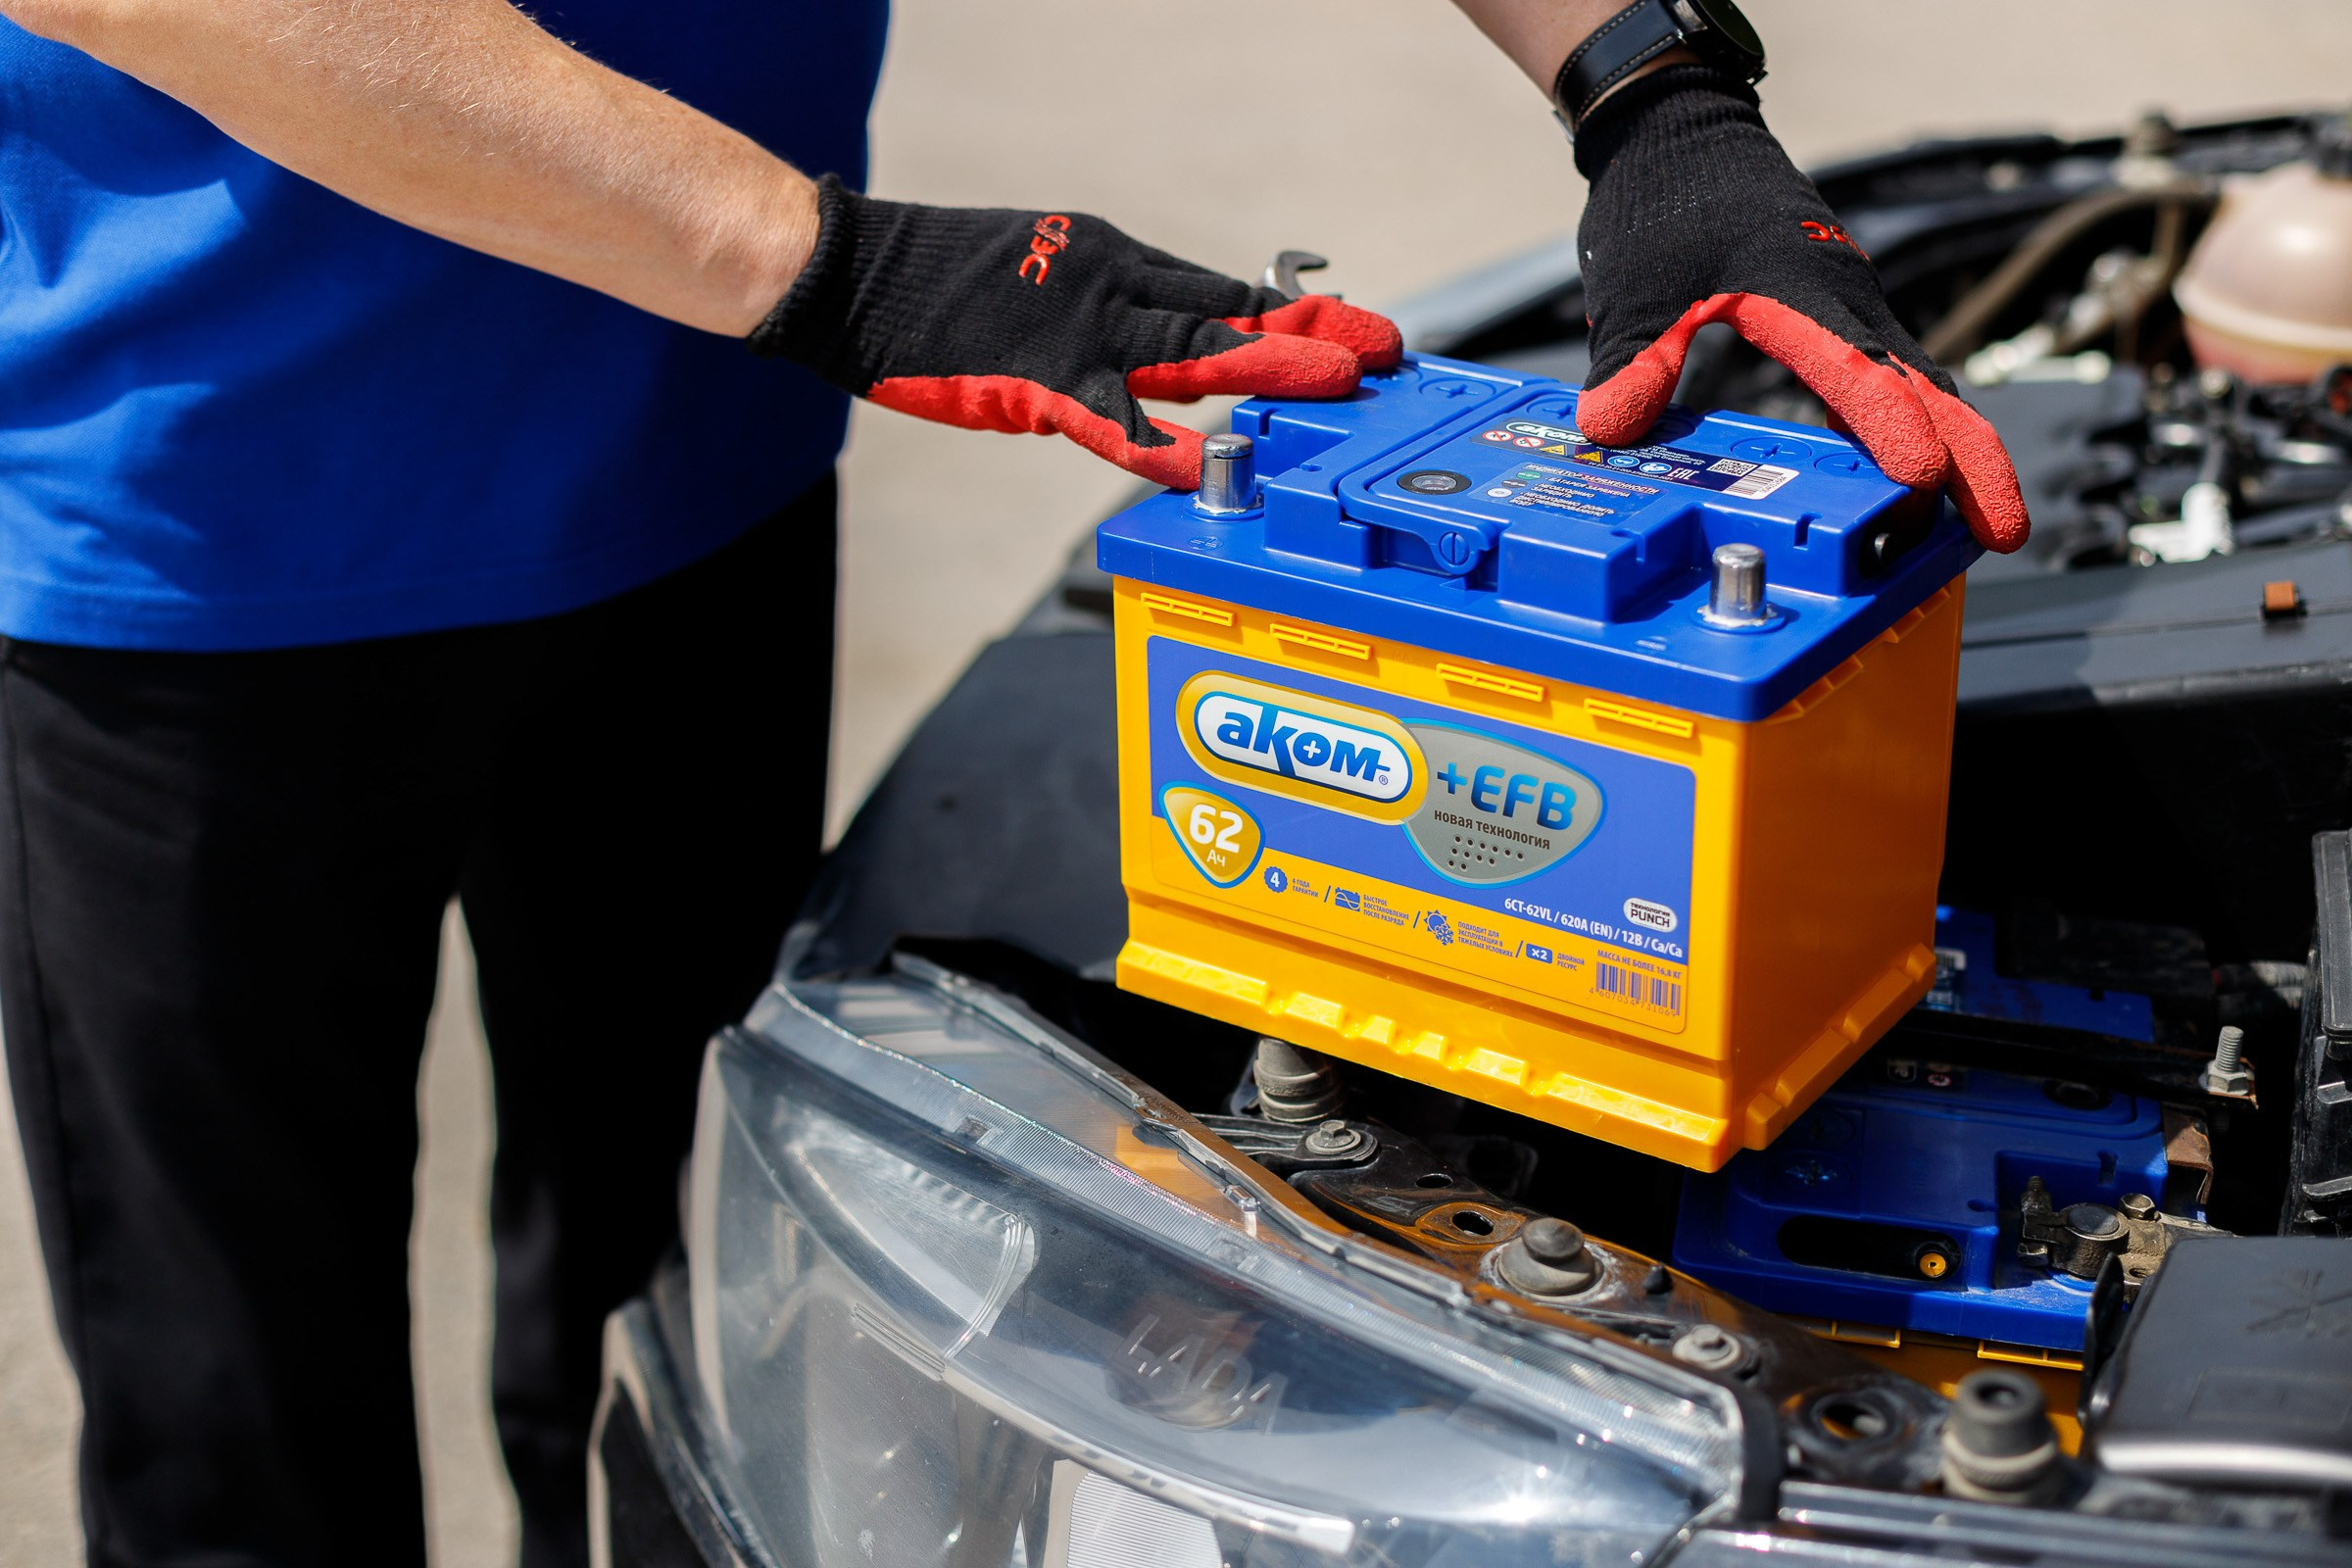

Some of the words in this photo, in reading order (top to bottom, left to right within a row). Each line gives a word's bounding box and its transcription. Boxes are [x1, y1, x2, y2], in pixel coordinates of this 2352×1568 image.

[1188, 804, 1244, 855] 62
[1434, 808, 1474, 831] новая
[1475, 818, 1551, 851] технология
[1206, 849, 1227, 868] Ач
[1270, 871, 1281, 888] 4
[1297, 879, 1310, 888] ГОДА
[1292, 886, 1319, 898] ГАРАНТИИ
[1363, 894, 1388, 906] БЫСТРОЕ
[1363, 902, 1410, 920] ВОССТАНОВЛЕНИЕ
[1363, 908, 1380, 919] ПОСЛЕ
[1381, 914, 1404, 926] РАЗРЯДА
[1631, 908, 1671, 928] PUNCH
[1458, 921, 1487, 935] ПОДХОДИТ
[1488, 929, 1499, 938] ДЛЯ
[1458, 929, 1498, 946] ЭКСПЛУАТАЦИИ
[1590, 921, 1613, 940] (EN)
[1458, 936, 1485, 950] ТЯЖЕЛЫХ
[1486, 944, 1513, 957] УСЛОВИЯХ
[1557, 953, 1585, 965] ДВОЙНОЙ
[1557, 960, 1577, 971] РЕСУРС
[1596, 949, 1621, 963] МАССА
[1622, 956, 1631, 965] НЕ
[1632, 958, 1654, 972] БОЛЕЕ
[1673, 970, 1682, 979] КГ
[1112, 1313, 1290, 1435] LADA
